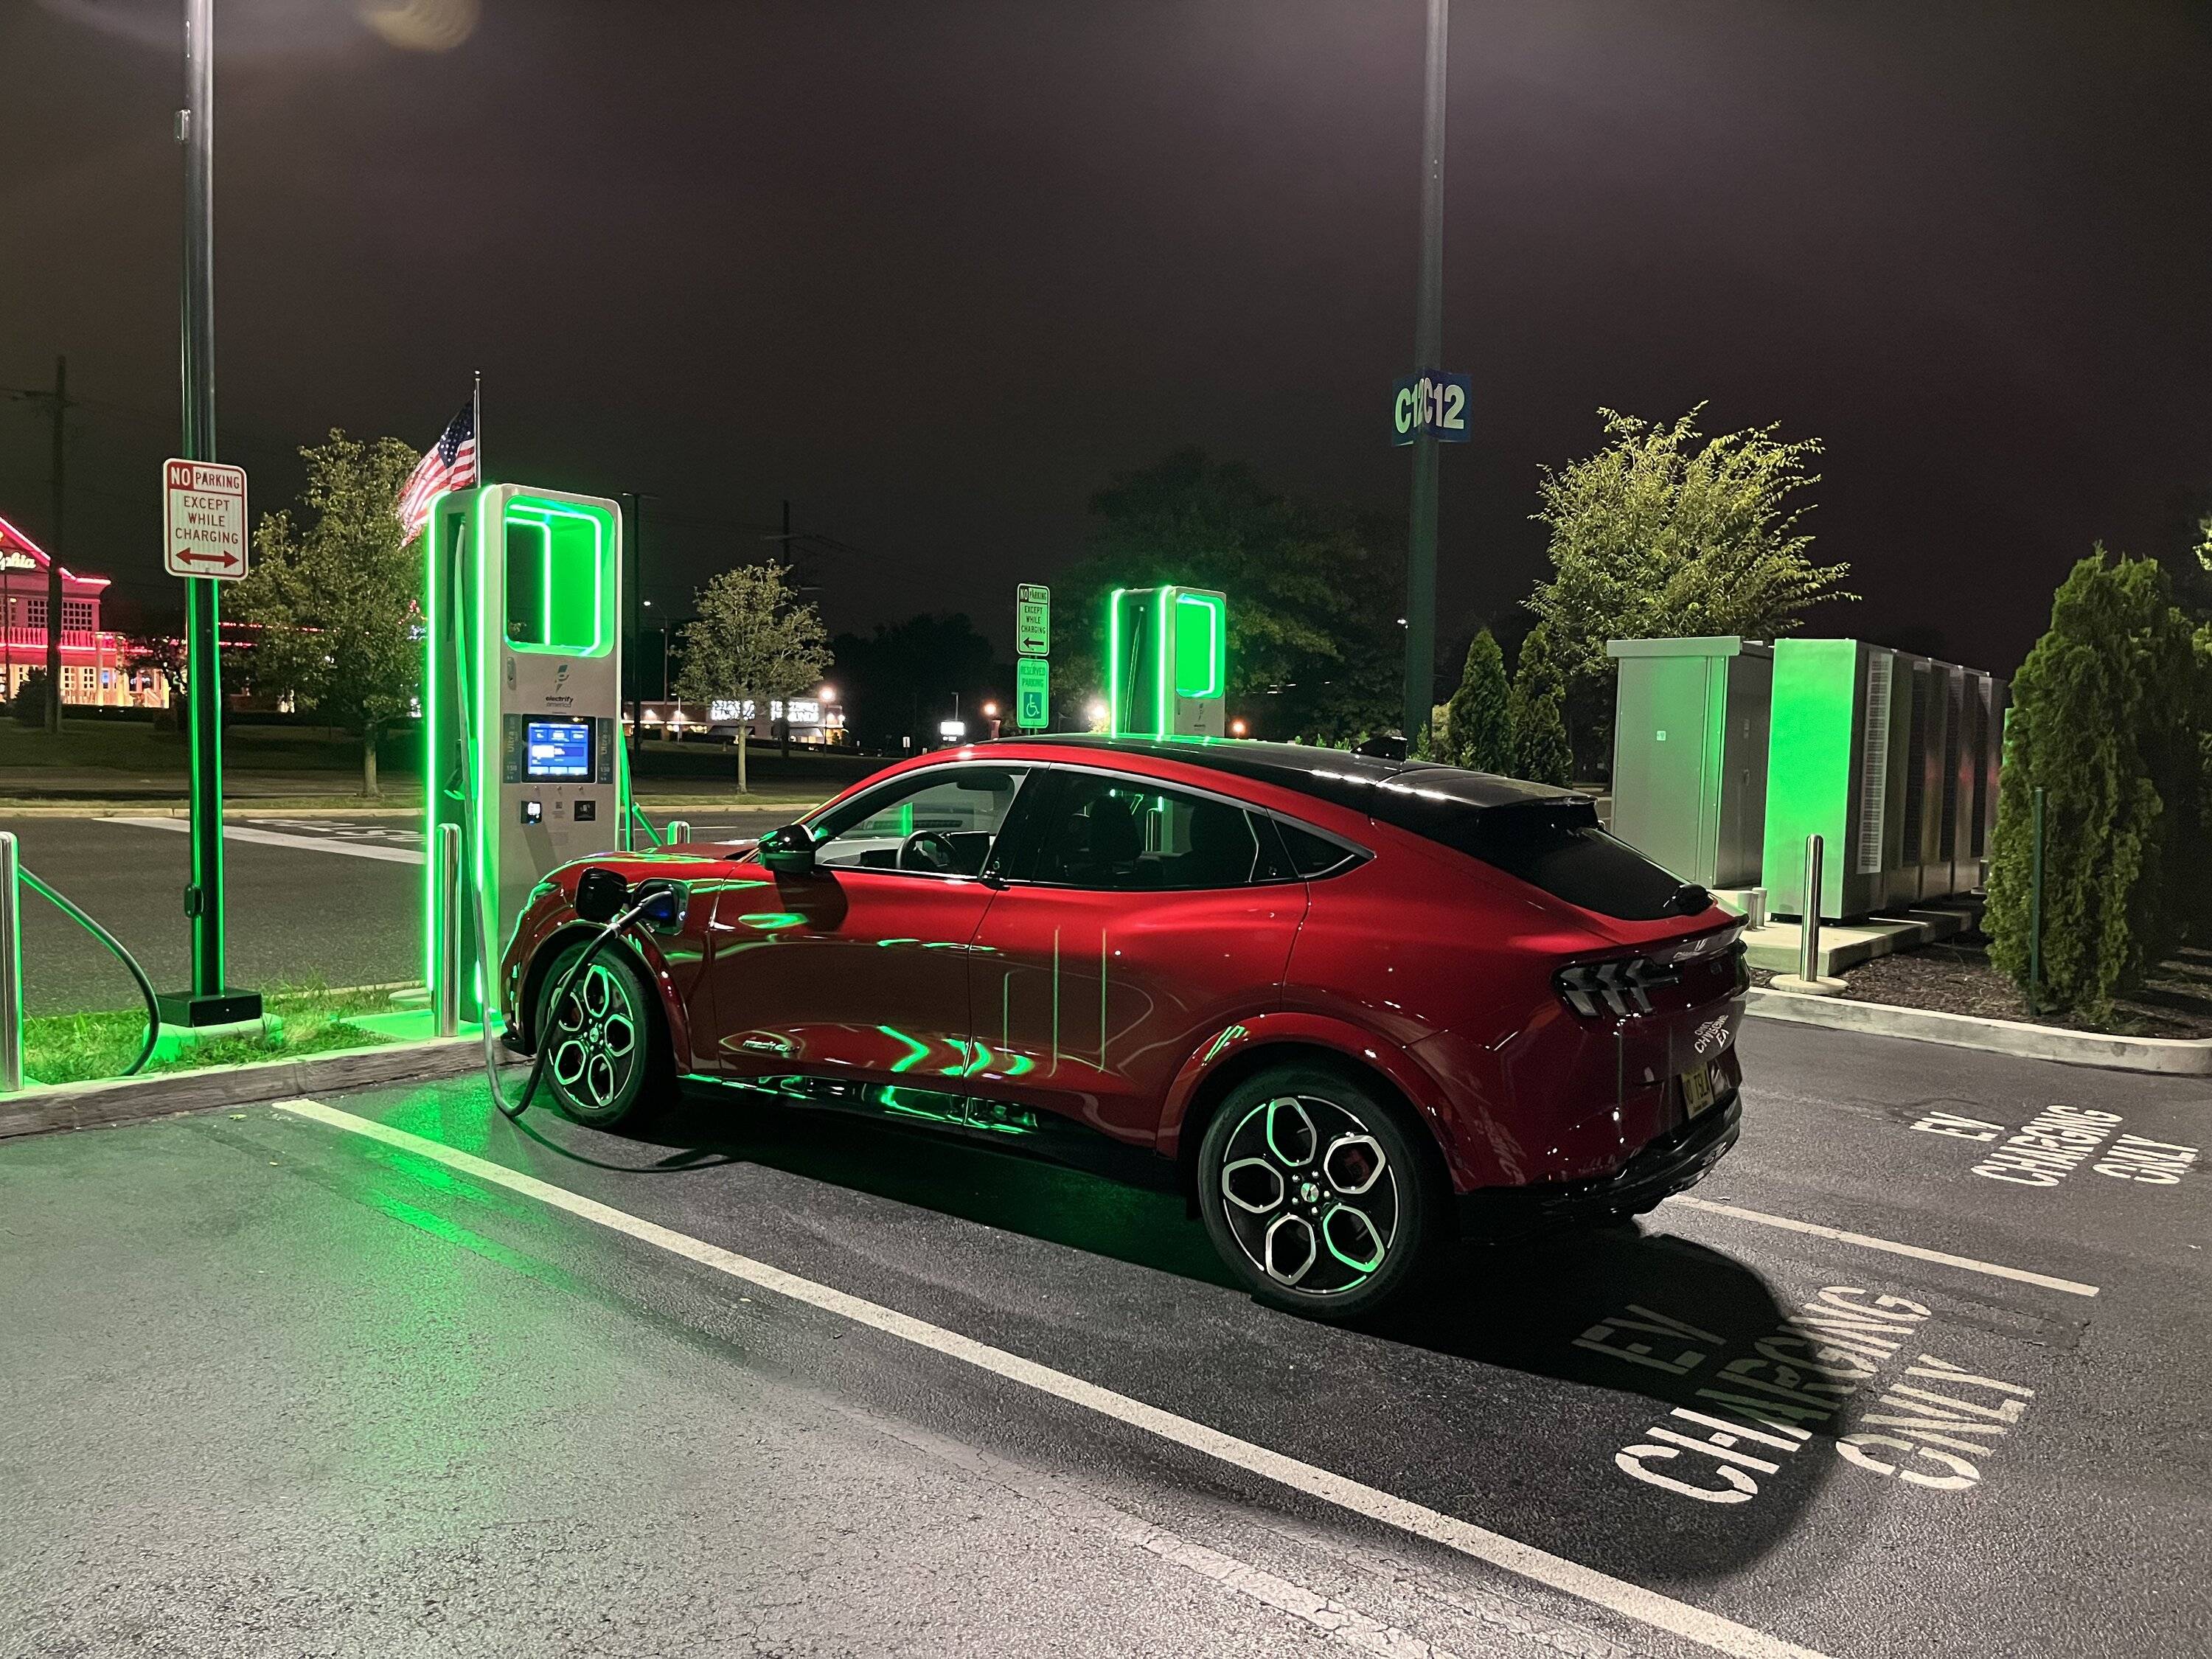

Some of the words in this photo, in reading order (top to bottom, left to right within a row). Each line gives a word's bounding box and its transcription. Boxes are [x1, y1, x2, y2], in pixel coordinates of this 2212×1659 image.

[1424, 377, 1465, 429] C12
[170, 466, 190, 487] NO
[195, 471, 240, 490] PARKING
[184, 495, 230, 511] EXCEPT
[188, 512, 225, 527] WHILE
[175, 527, 238, 544] CHARGING
[1020, 588, 1028, 600] NO
[1029, 591, 1047, 601] PARKING
[1024, 605, 1043, 615] EXCEPT
[1026, 616, 1041, 625] WHILE
[1020, 625, 1046, 635] CHARGING
[1020, 666, 1046, 675] RESERVED
[1021, 678, 1044, 688] PARKING
[546, 695, 574, 703] electrify
[1909, 1111, 2005, 1142] EV
[1971, 1105, 2124, 1187] CHARGING
[2093, 1133, 2199, 1185] ONLY
[1571, 1304, 1727, 1375] EV
[1615, 1286, 1932, 1503] CHARGING
[1835, 1353, 2036, 1490] ONLY
